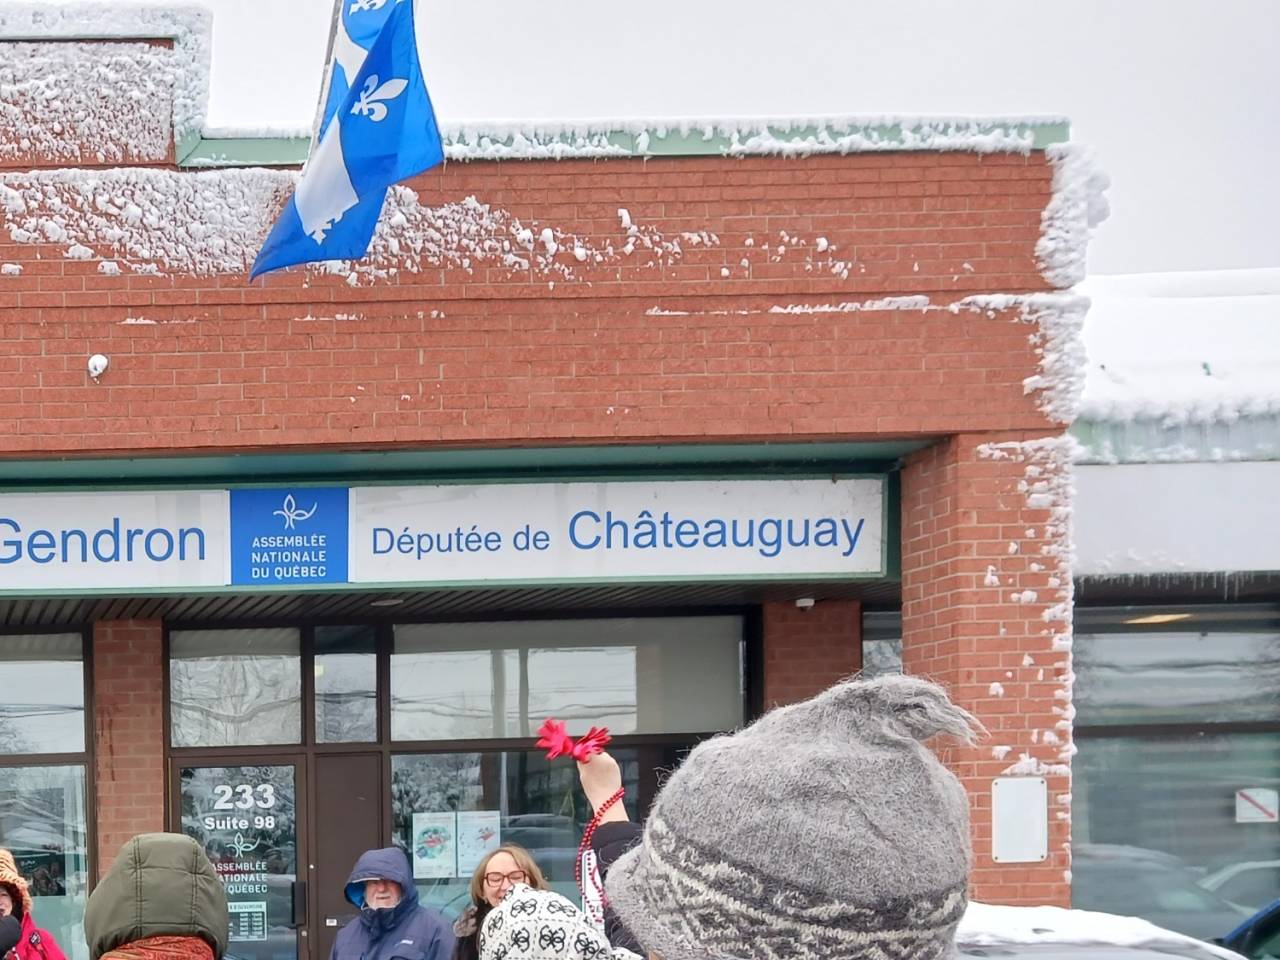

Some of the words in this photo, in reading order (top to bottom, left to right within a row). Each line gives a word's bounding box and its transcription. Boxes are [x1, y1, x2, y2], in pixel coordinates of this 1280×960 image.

[252, 534, 327, 548] ASSEMBLÉE
[372, 526, 502, 561] Députée
[512, 523, 551, 551] de
[567, 509, 866, 559] Châteauguay
[251, 551, 326, 563] NATIONALE
[251, 567, 269, 579] DU
[274, 564, 327, 580] QUÉBEC
[213, 783, 276, 810] 233
[204, 816, 249, 830] Suite
[254, 816, 275, 829] 98
[218, 873, 268, 883] ATIONALE
[227, 884, 268, 895] QUÉBEC
